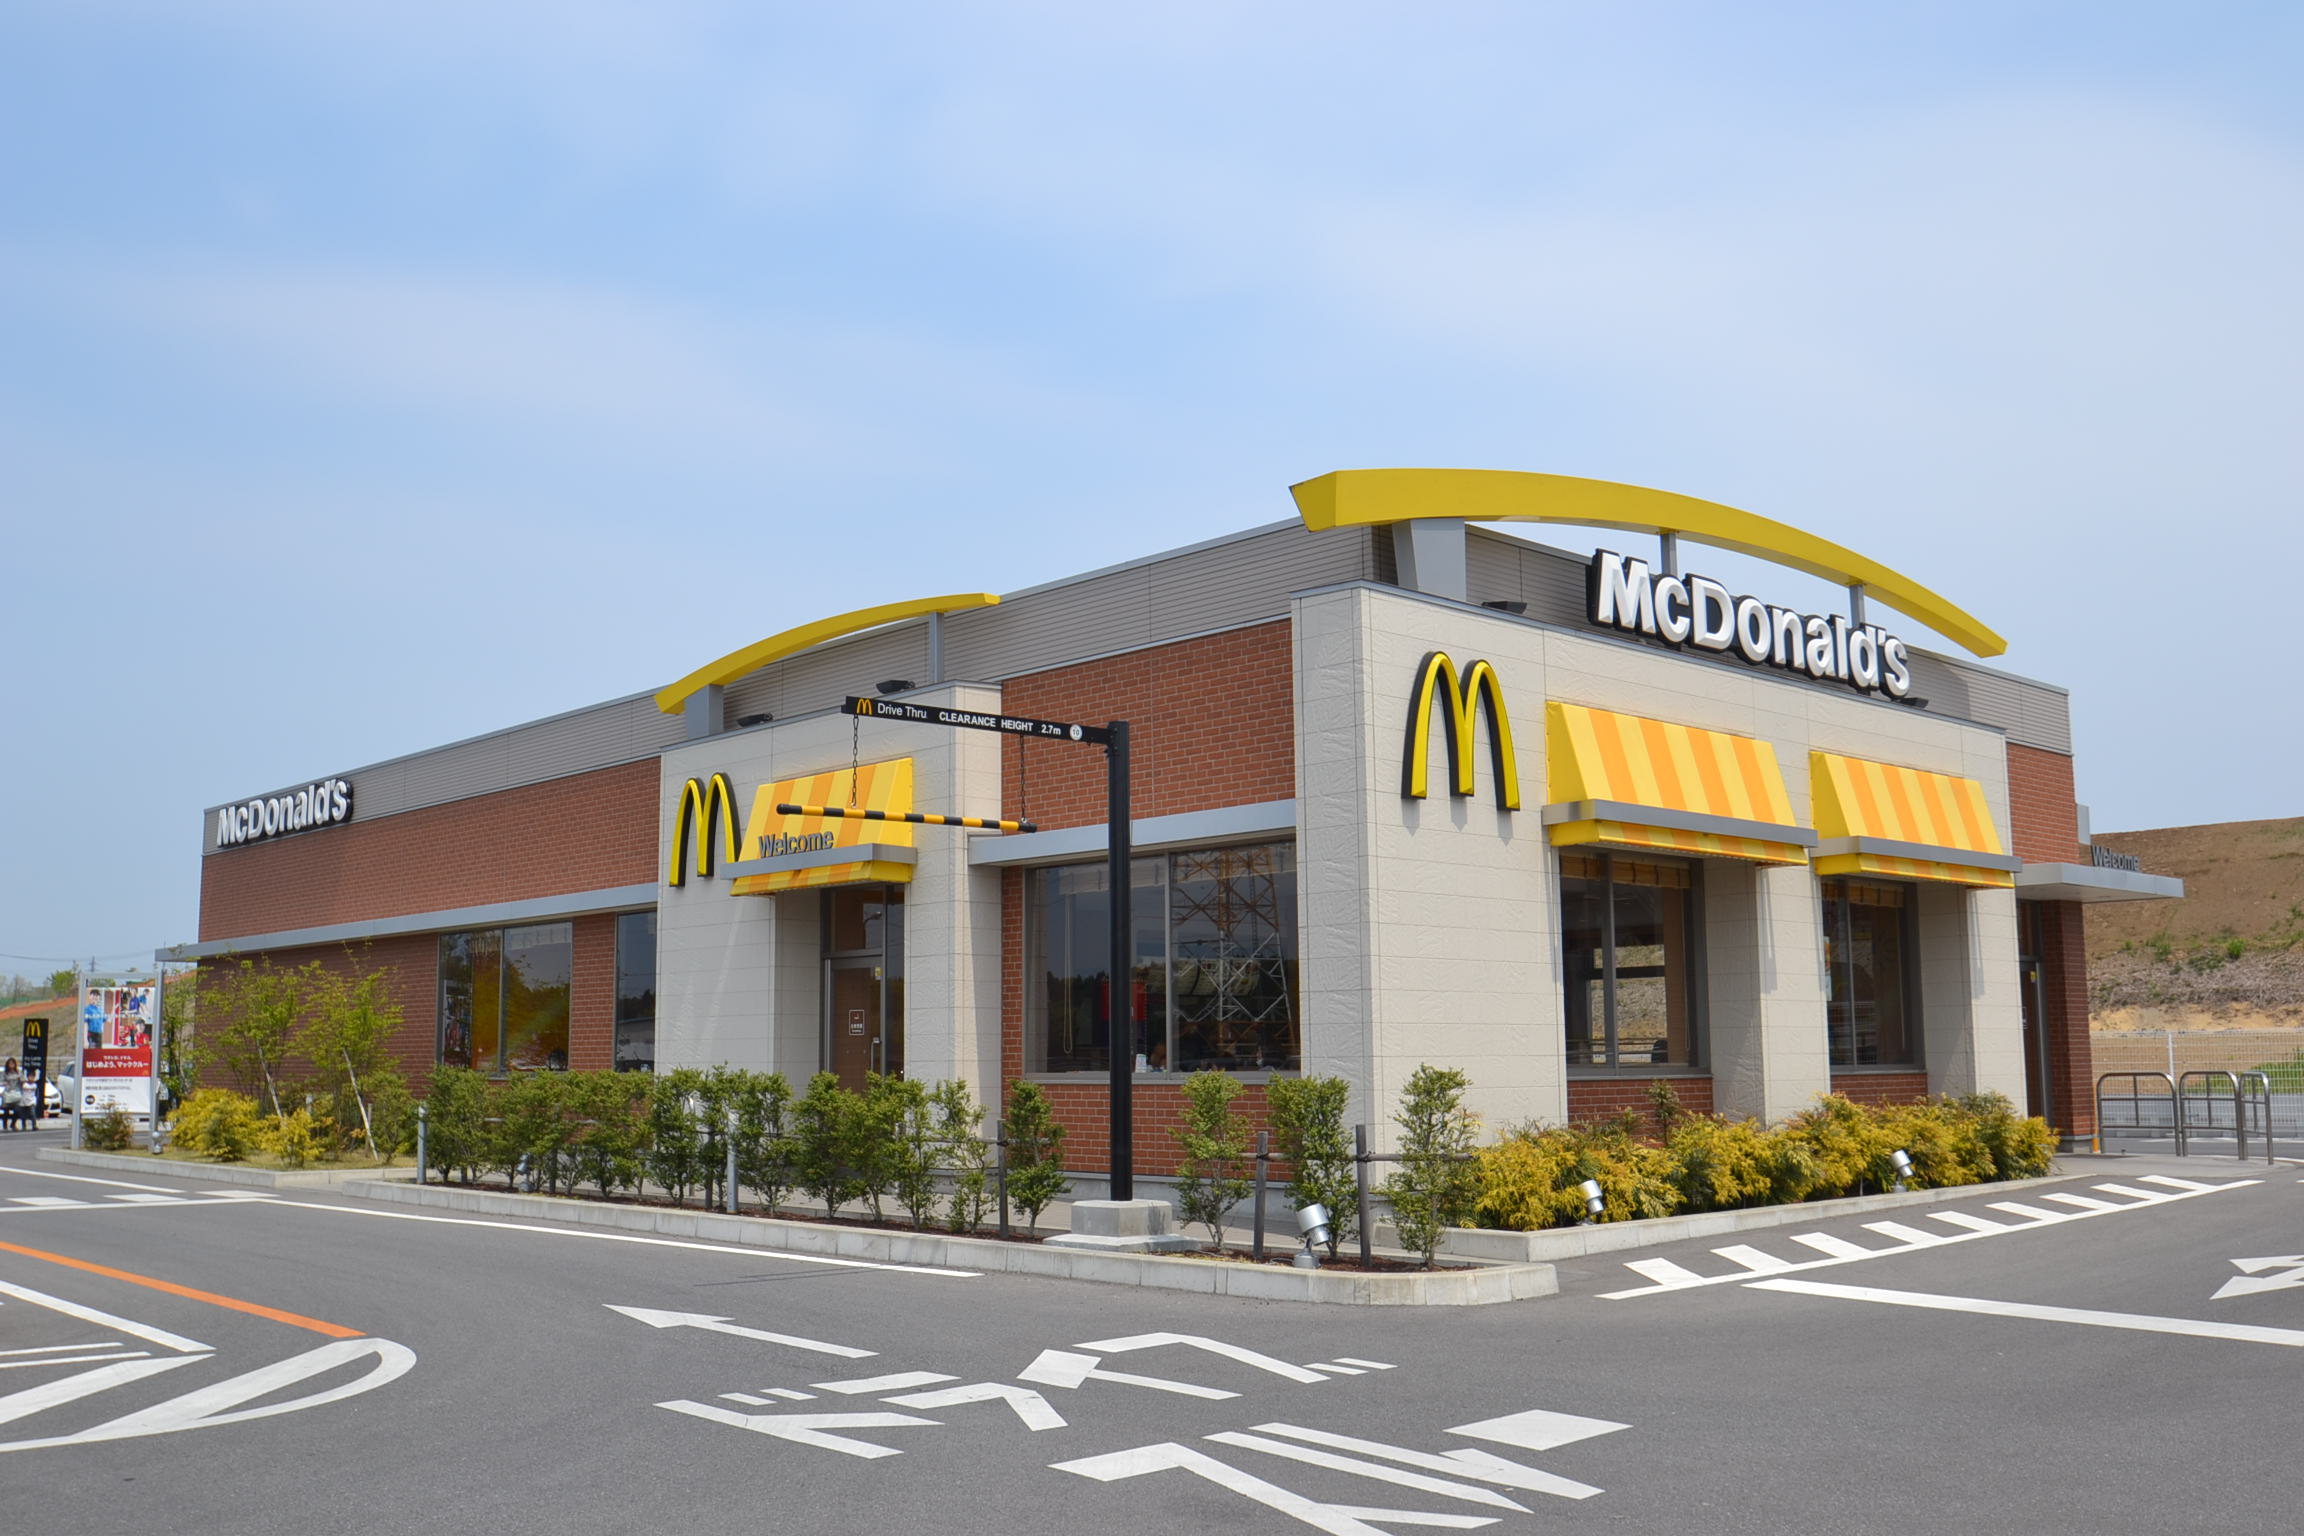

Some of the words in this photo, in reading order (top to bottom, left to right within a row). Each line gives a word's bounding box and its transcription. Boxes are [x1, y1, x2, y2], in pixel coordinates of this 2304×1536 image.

[1594, 549, 1912, 699] McDonald's
[877, 702, 903, 716] Drive
[905, 704, 927, 719] Thru
[939, 711, 996, 728] CLEARANCE
[1001, 718, 1034, 732] HEIGHT
[1041, 723, 1062, 736] 2.7m
[216, 778, 350, 847] McDonald's
[758, 831, 834, 858] Welcome
[2090, 844, 2141, 871] Welcome
